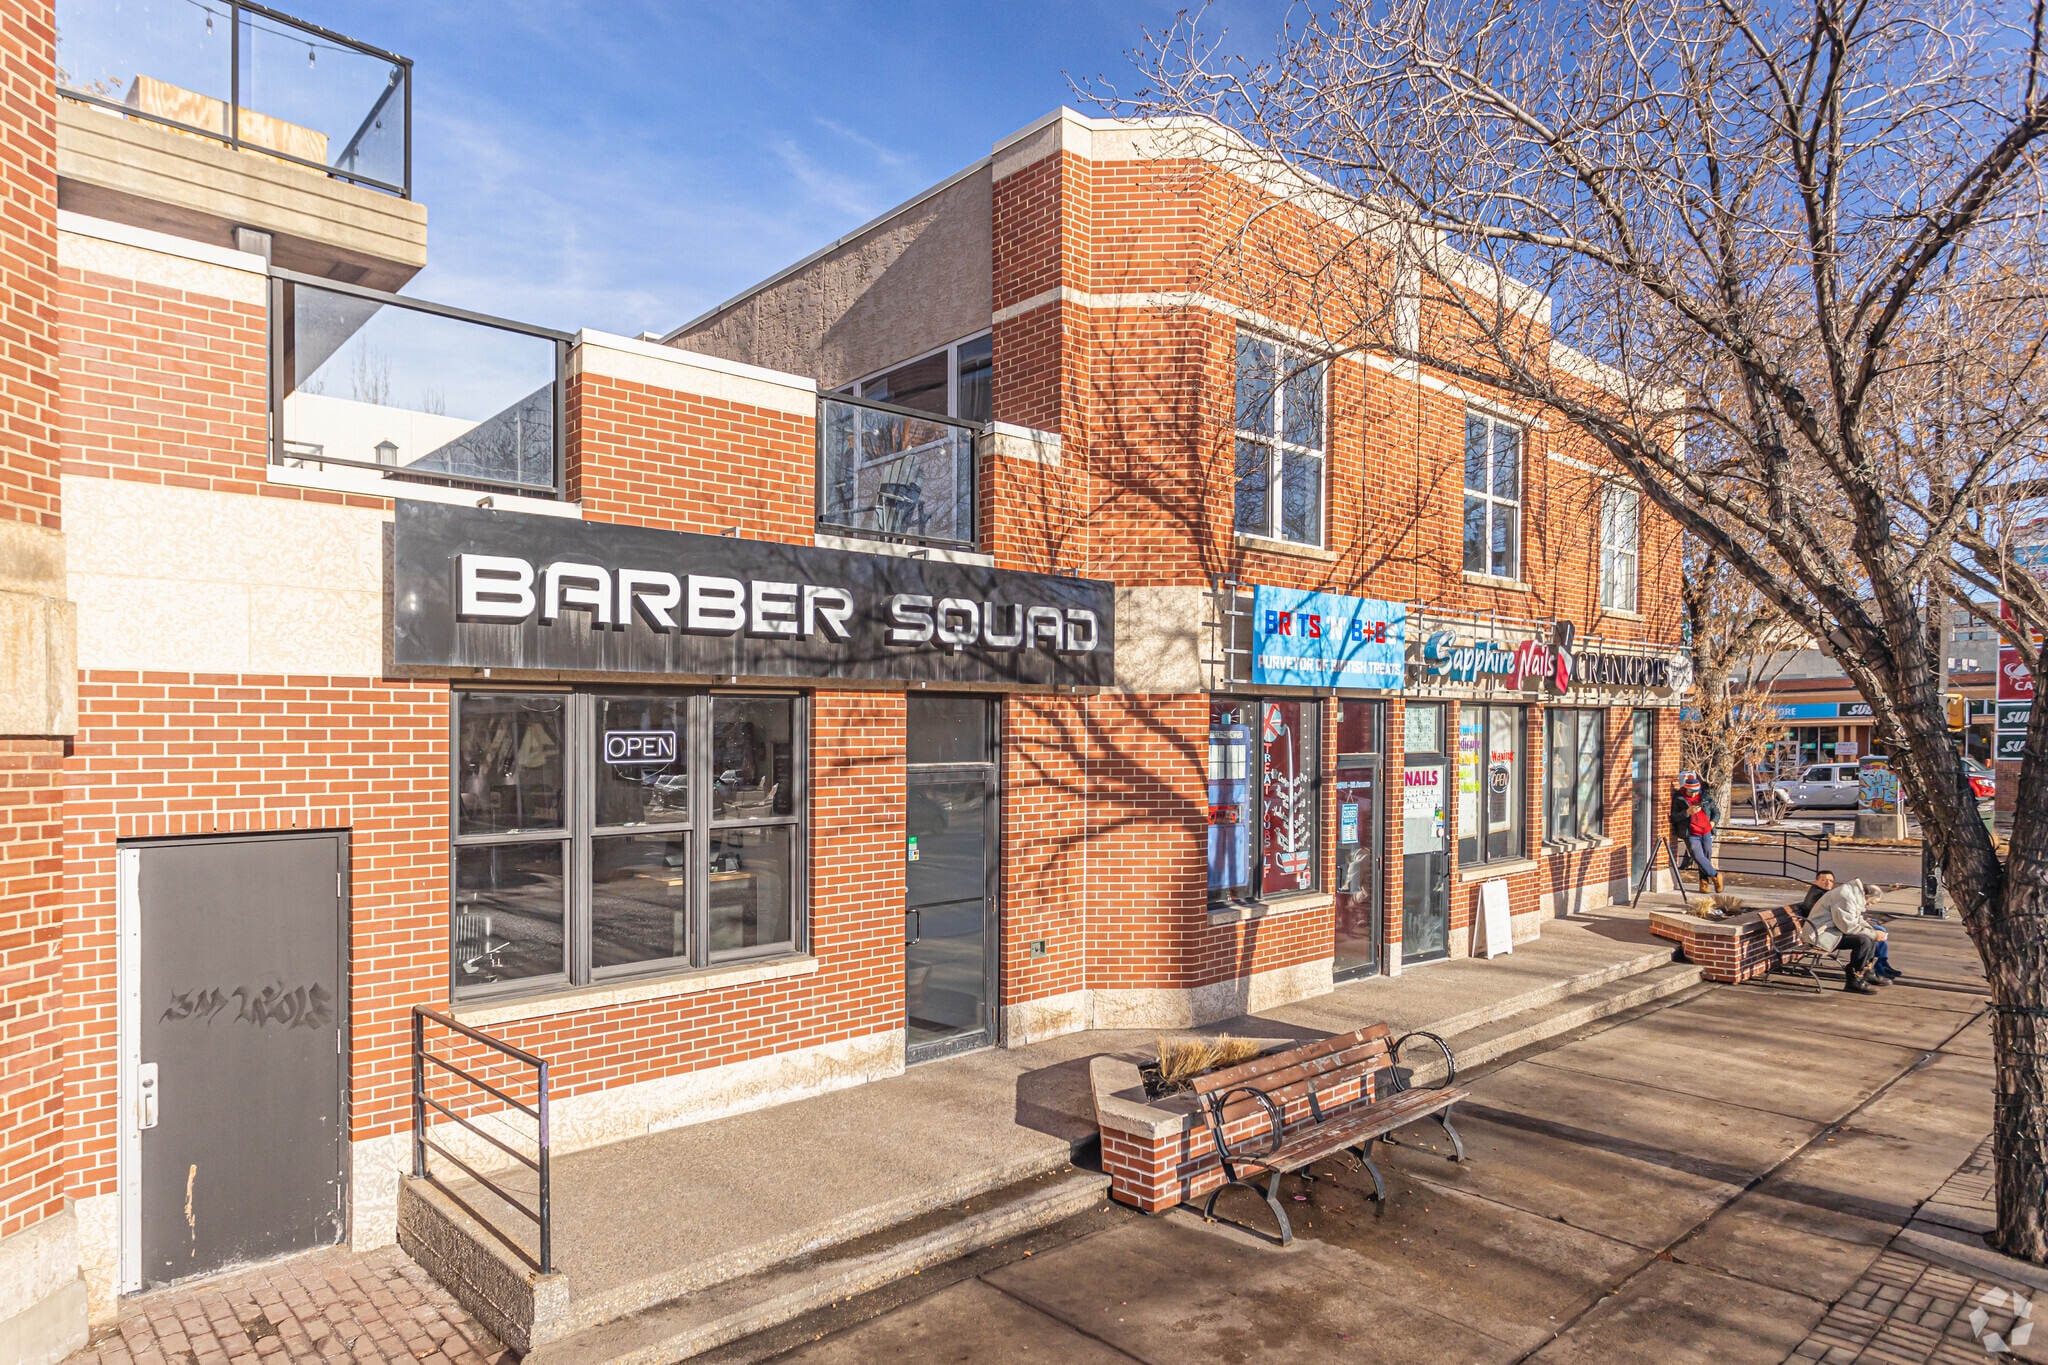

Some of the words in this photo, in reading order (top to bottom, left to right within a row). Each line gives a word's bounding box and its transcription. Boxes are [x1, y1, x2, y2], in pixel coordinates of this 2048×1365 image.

[455, 552, 855, 643] BARBER
[884, 593, 1100, 656] SQUAD
[1265, 609, 1321, 638] BRITS
[1258, 654, 1314, 671] PURVEYOR
[1315, 658, 1330, 672] OF
[1330, 659, 1367, 674] BRITISH
[1368, 661, 1402, 676] TREATS
[1425, 629, 1516, 682] Sapphire
[1513, 638, 1556, 690] Nails
[1574, 651, 1670, 688] CRANKPOTS
[607, 736, 674, 758] OPEN
[1491, 750, 1515, 763] Waxing
[1263, 742, 1273, 795] TREAT
[1404, 770, 1439, 787] NAILS
[1492, 773, 1509, 787] OPEN
[1263, 800, 1272, 878] YOURSELF
